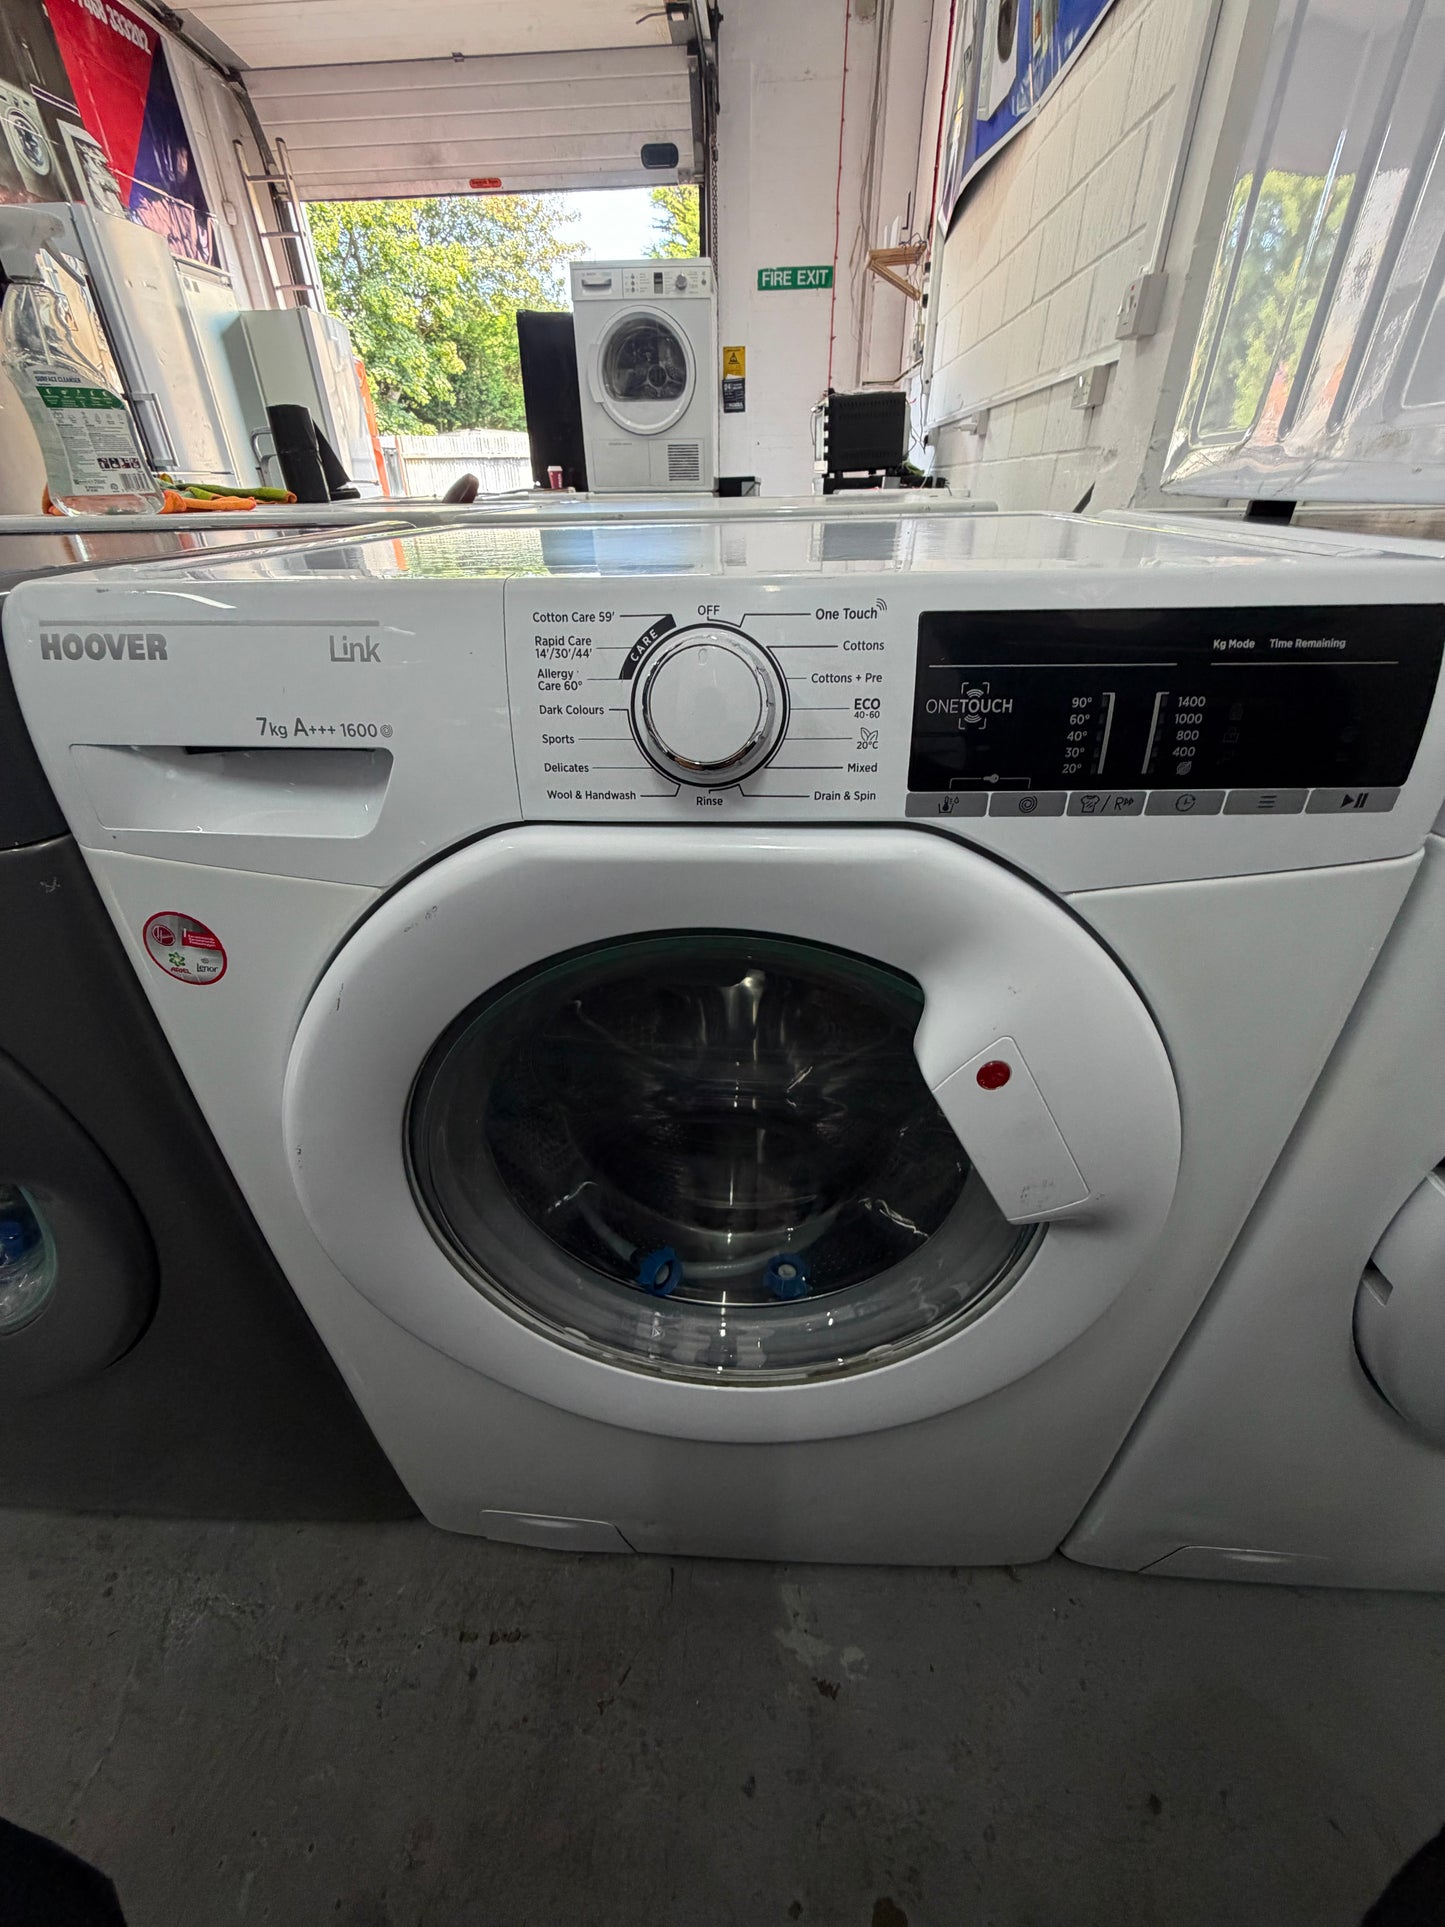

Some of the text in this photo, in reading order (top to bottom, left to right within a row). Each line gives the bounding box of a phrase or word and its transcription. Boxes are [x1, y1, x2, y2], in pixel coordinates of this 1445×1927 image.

[762, 270, 829, 286] FIRE EXIT
[697, 605, 720, 615] OFF
[815, 607, 878, 620] One Touch
[532, 612, 568, 623] Cotton
[572, 612, 596, 622] Care
[40, 633, 168, 660] HOOVER
[535, 636, 592, 647] Rapid Care
[630, 628, 659, 662] CARE
[843, 640, 885, 651] Cottons
[1213, 639, 1256, 650] Kg Mode
[1269, 638, 1346, 650] Time Remaining
[329, 635, 381, 662] Link
[535, 648, 592, 660] 14'/30'/44'
[537, 669, 574, 680] Allergy
[811, 673, 852, 683] Cottons
[865, 673, 882, 683] Pre
[538, 681, 582, 691] Care 60°
[854, 698, 881, 710] ECO
[926, 699, 1013, 714] ONETOUCH
[1071, 697, 1092, 708] 90°
[1178, 696, 1206, 707] 1400
[539, 705, 604, 715] Dark Colours
[854, 711, 880, 719] 40-60
[1069, 714, 1090, 725] 60°
[1175, 713, 1203, 724] 1000
[256, 717, 377, 739] 7kg A+++ 1600
[542, 734, 575, 745] Sports
[1067, 731, 1087, 741] 40°
[1176, 730, 1199, 741] 800
[857, 741, 879, 750] 20°C
[1064, 747, 1085, 758] 30°
[1172, 747, 1196, 757] 400
[544, 763, 589, 772] Delicates
[847, 763, 877, 773] Mixed
[1062, 763, 1082, 774] 20°
[547, 790, 636, 800] Wool & Handwash
[814, 791, 876, 802] Drain & Spin
[696, 796, 723, 806] Rinse
[197, 963, 218, 972] Lenor
